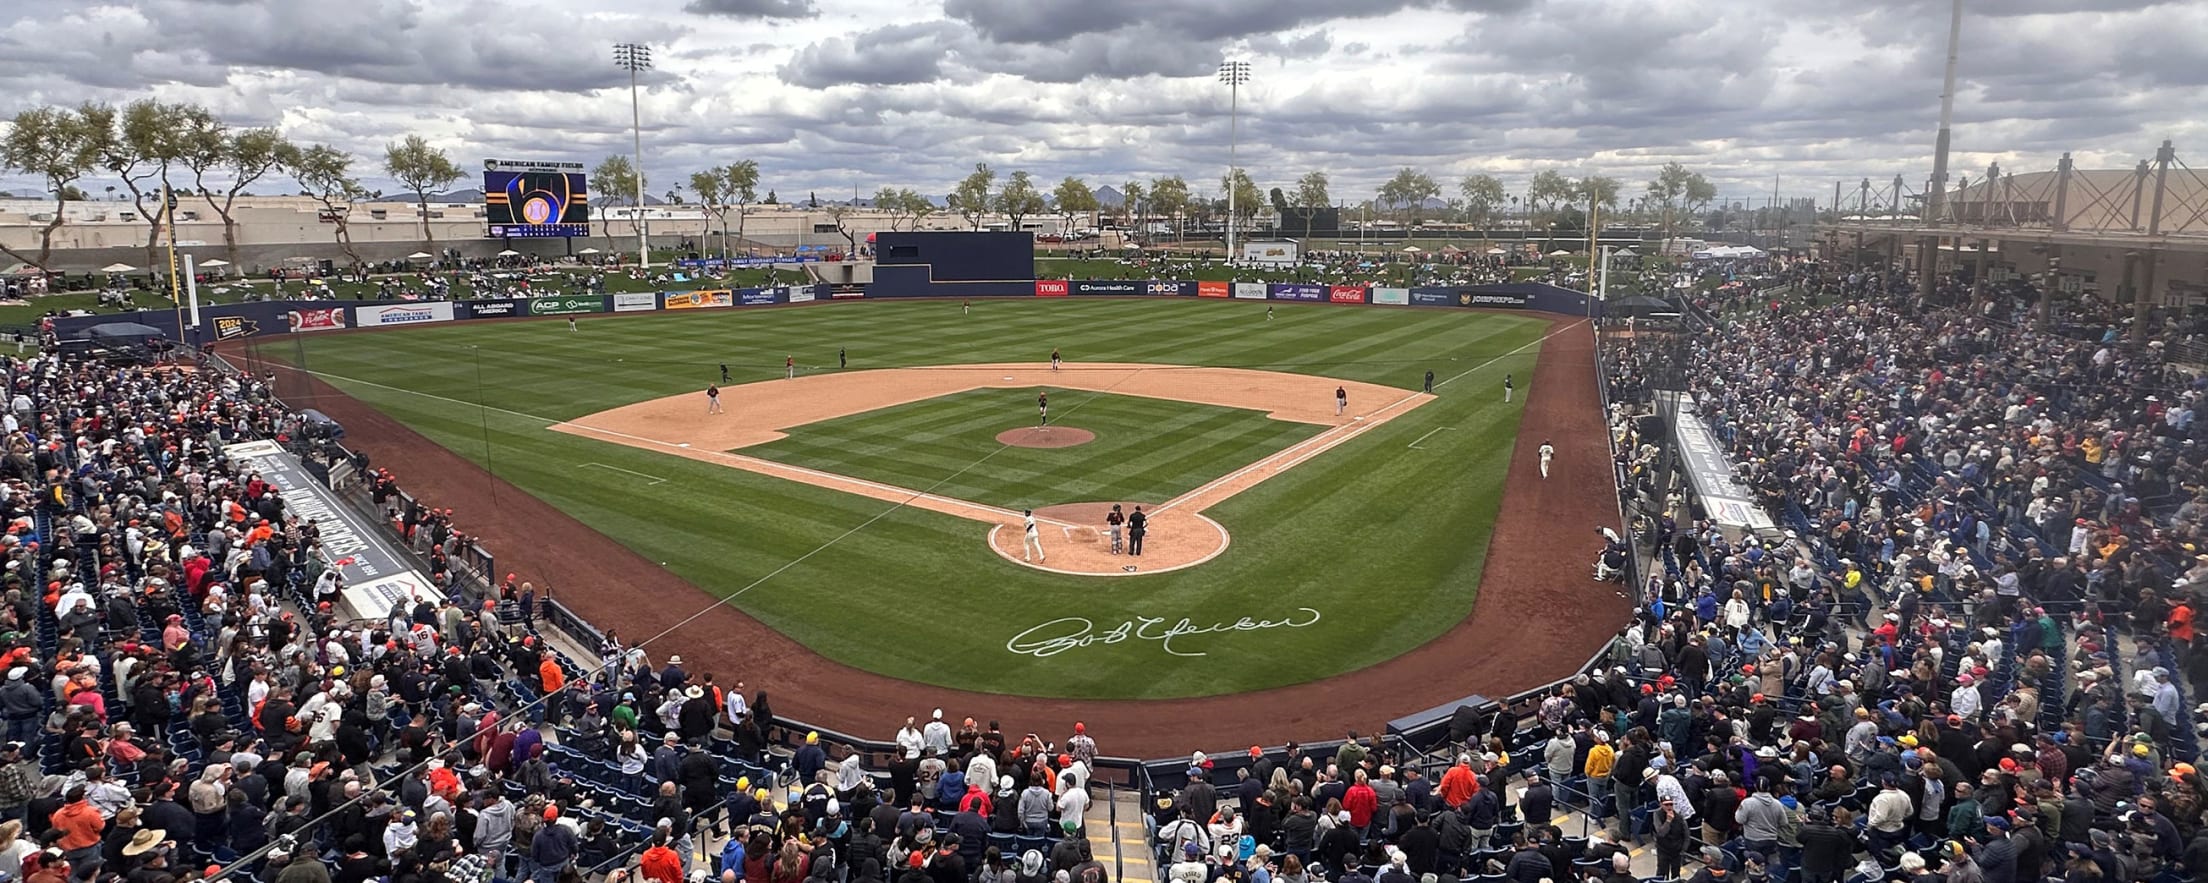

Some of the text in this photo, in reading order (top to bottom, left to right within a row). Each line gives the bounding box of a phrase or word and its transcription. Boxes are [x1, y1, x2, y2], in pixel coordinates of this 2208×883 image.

[1039, 284, 1064, 292] TORO
[1147, 281, 1178, 294] poba
[535, 301, 560, 311] ACP
[218, 319, 242, 329] 2024
[315, 519, 369, 556] BREWERS
[416, 630, 429, 642] 16
[1006, 617, 1133, 657] Bob
[922, 771, 940, 783] 24
[1221, 832, 1240, 845] 23
